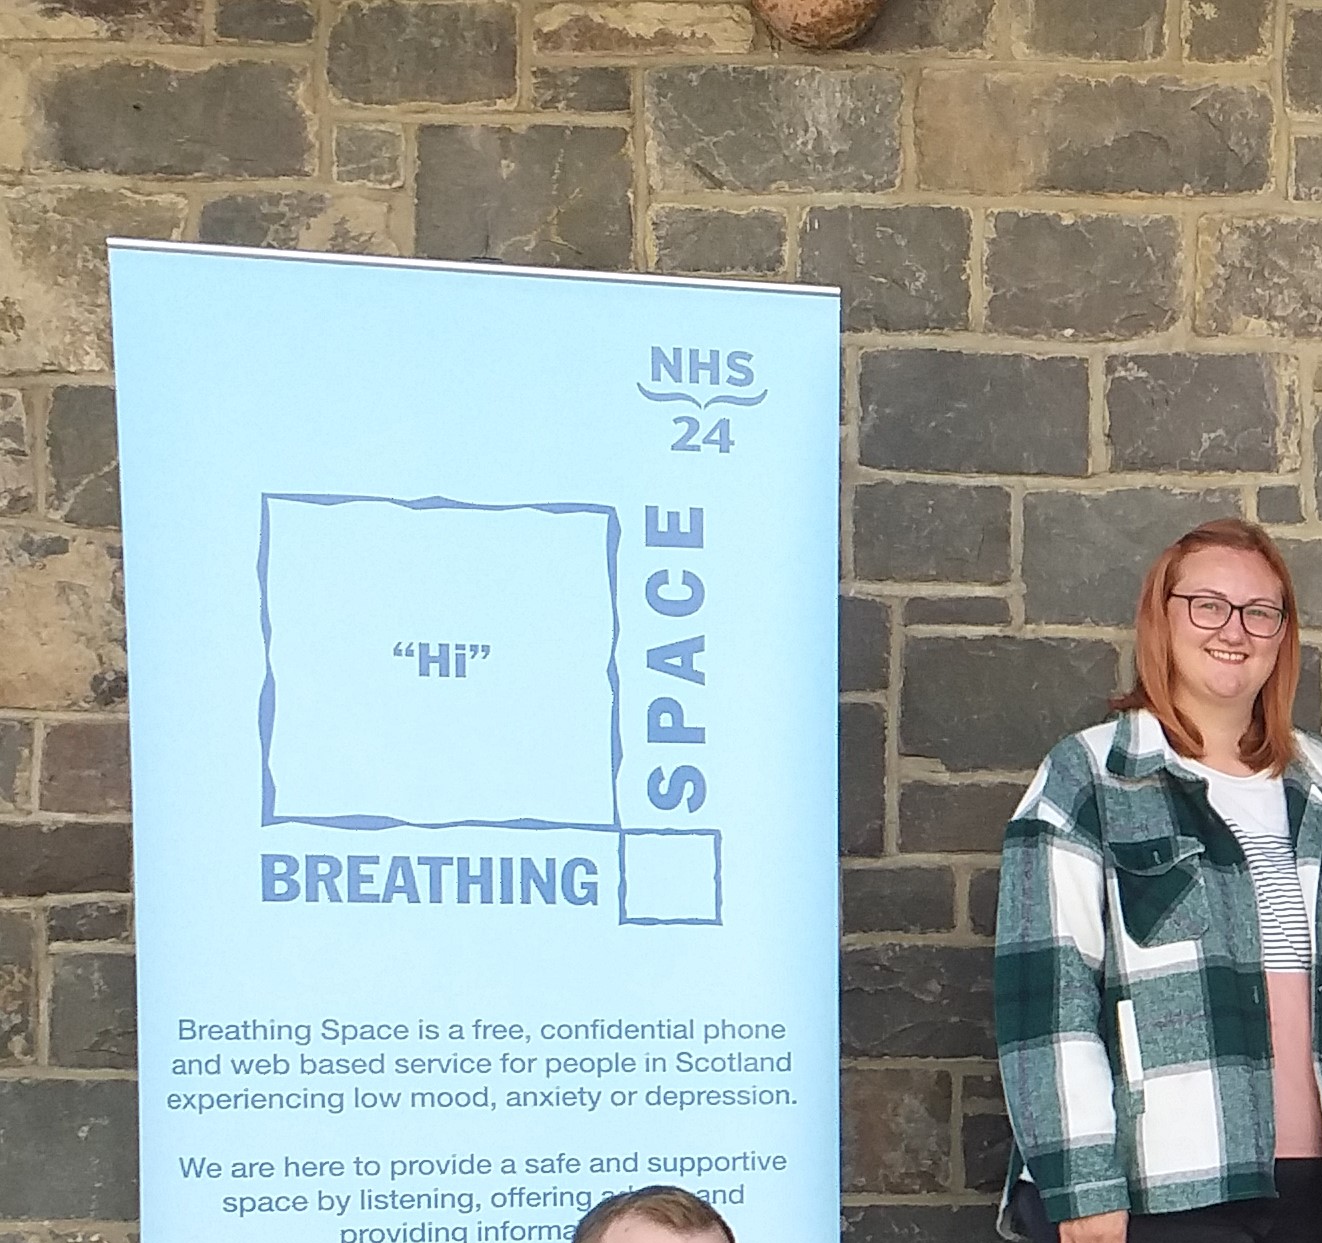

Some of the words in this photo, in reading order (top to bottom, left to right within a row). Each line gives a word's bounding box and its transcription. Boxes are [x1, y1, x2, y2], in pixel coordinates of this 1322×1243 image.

[651, 346, 754, 387] NHS
[671, 416, 735, 453] 24
[645, 505, 706, 813] SPACE
[261, 854, 598, 905] BREATHING
[179, 1019, 311, 1045] Breathing
[322, 1019, 409, 1045] Space
[419, 1019, 439, 1040] is
[449, 1024, 465, 1039] a
[472, 1019, 530, 1043] free,
[541, 1019, 693, 1039] confidential
[704, 1019, 785, 1044] phone
[172, 1054, 220, 1075] and
[231, 1054, 289, 1075] web
[301, 1053, 384, 1075] based
[395, 1053, 491, 1074] service
[499, 1053, 537, 1073] for
[546, 1052, 636, 1078] people
[646, 1053, 666, 1072] in
[676, 1052, 791, 1072] Scotland
[167, 1088, 344, 1114] experiencing
[355, 1087, 401, 1108] low
[412, 1086, 496, 1111] mood,
[507, 1086, 601, 1111] anxiety
[611, 1091, 637, 1106] or
[646, 1085, 797, 1110] depression.
[179, 1157, 222, 1178] We
[232, 1162, 275, 1178] are
[285, 1156, 344, 1177] here
[353, 1157, 380, 1176] to
[391, 1154, 491, 1181] provide
[501, 1159, 516, 1174] a
[525, 1153, 581, 1173] safe
[590, 1152, 638, 1173] and
[648, 1152, 787, 1177] supportive
[223, 1196, 309, 1217] space
[318, 1190, 351, 1216] by
[361, 1188, 480, 1213] listening,
[491, 1188, 592, 1215] offering
[698, 1182, 744, 1205] and
